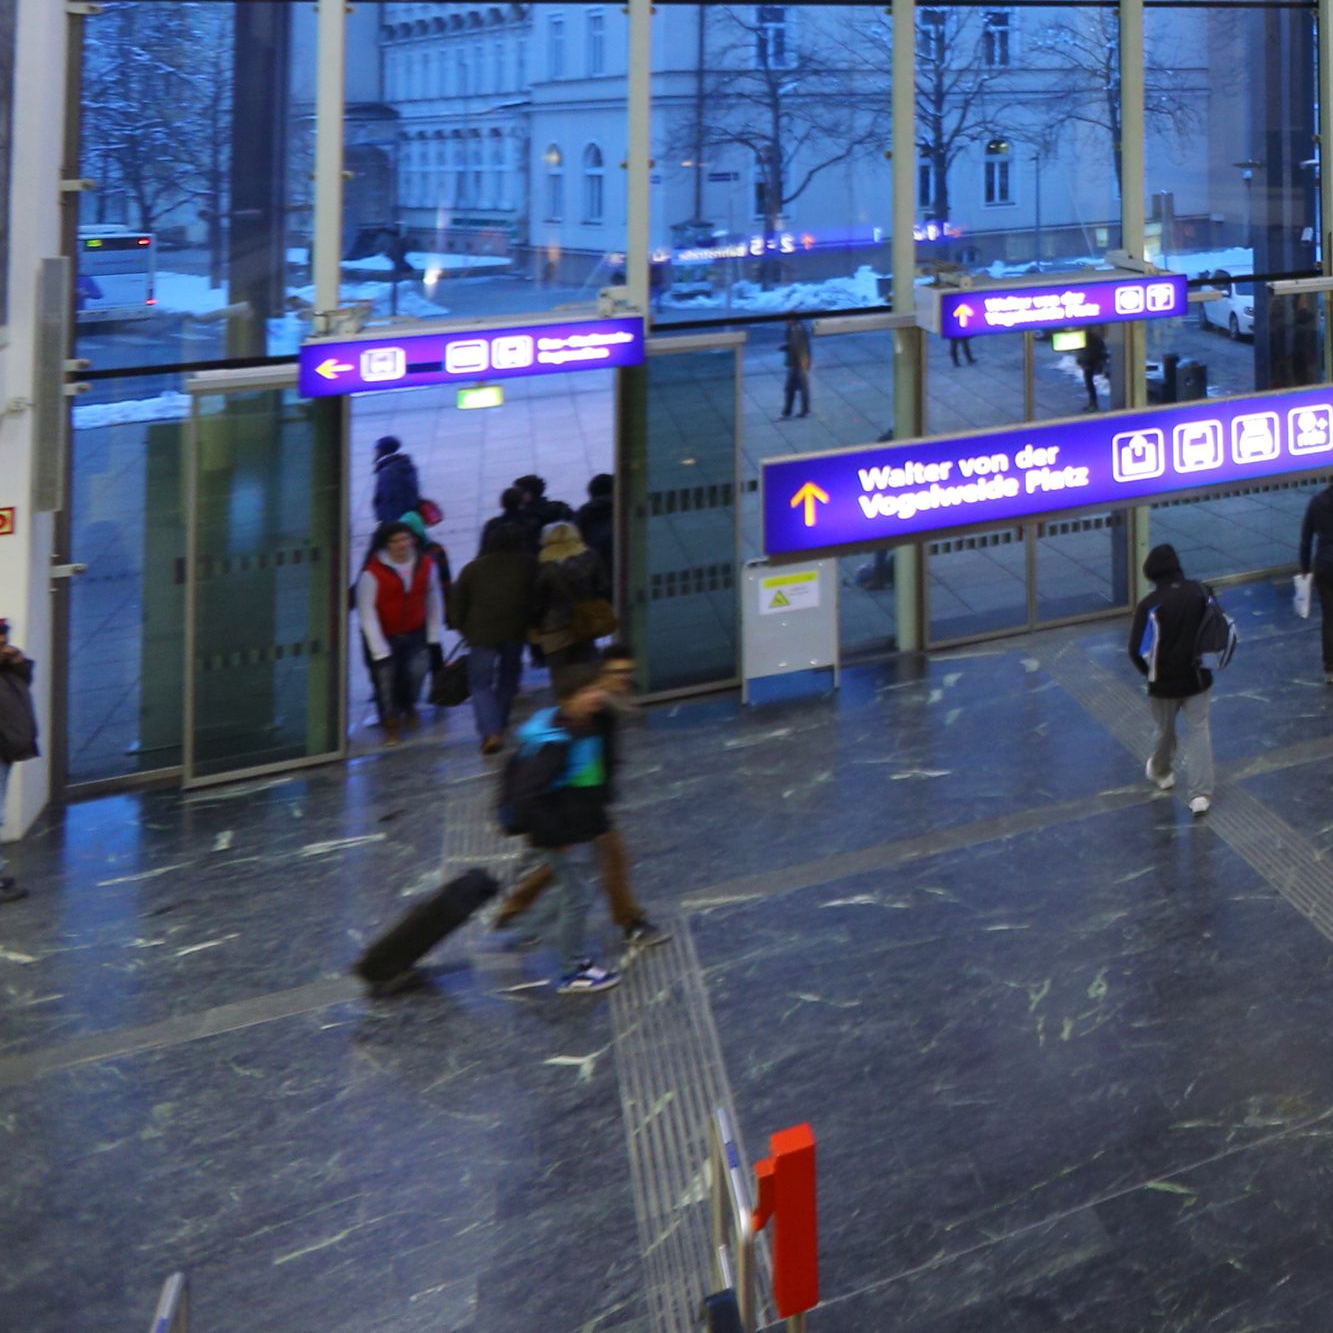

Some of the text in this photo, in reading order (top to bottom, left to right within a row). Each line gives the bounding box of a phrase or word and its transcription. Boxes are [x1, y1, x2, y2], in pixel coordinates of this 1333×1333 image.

[858, 444, 1060, 492] Walter von der
[858, 466, 1090, 519] Vogelweide Platz
